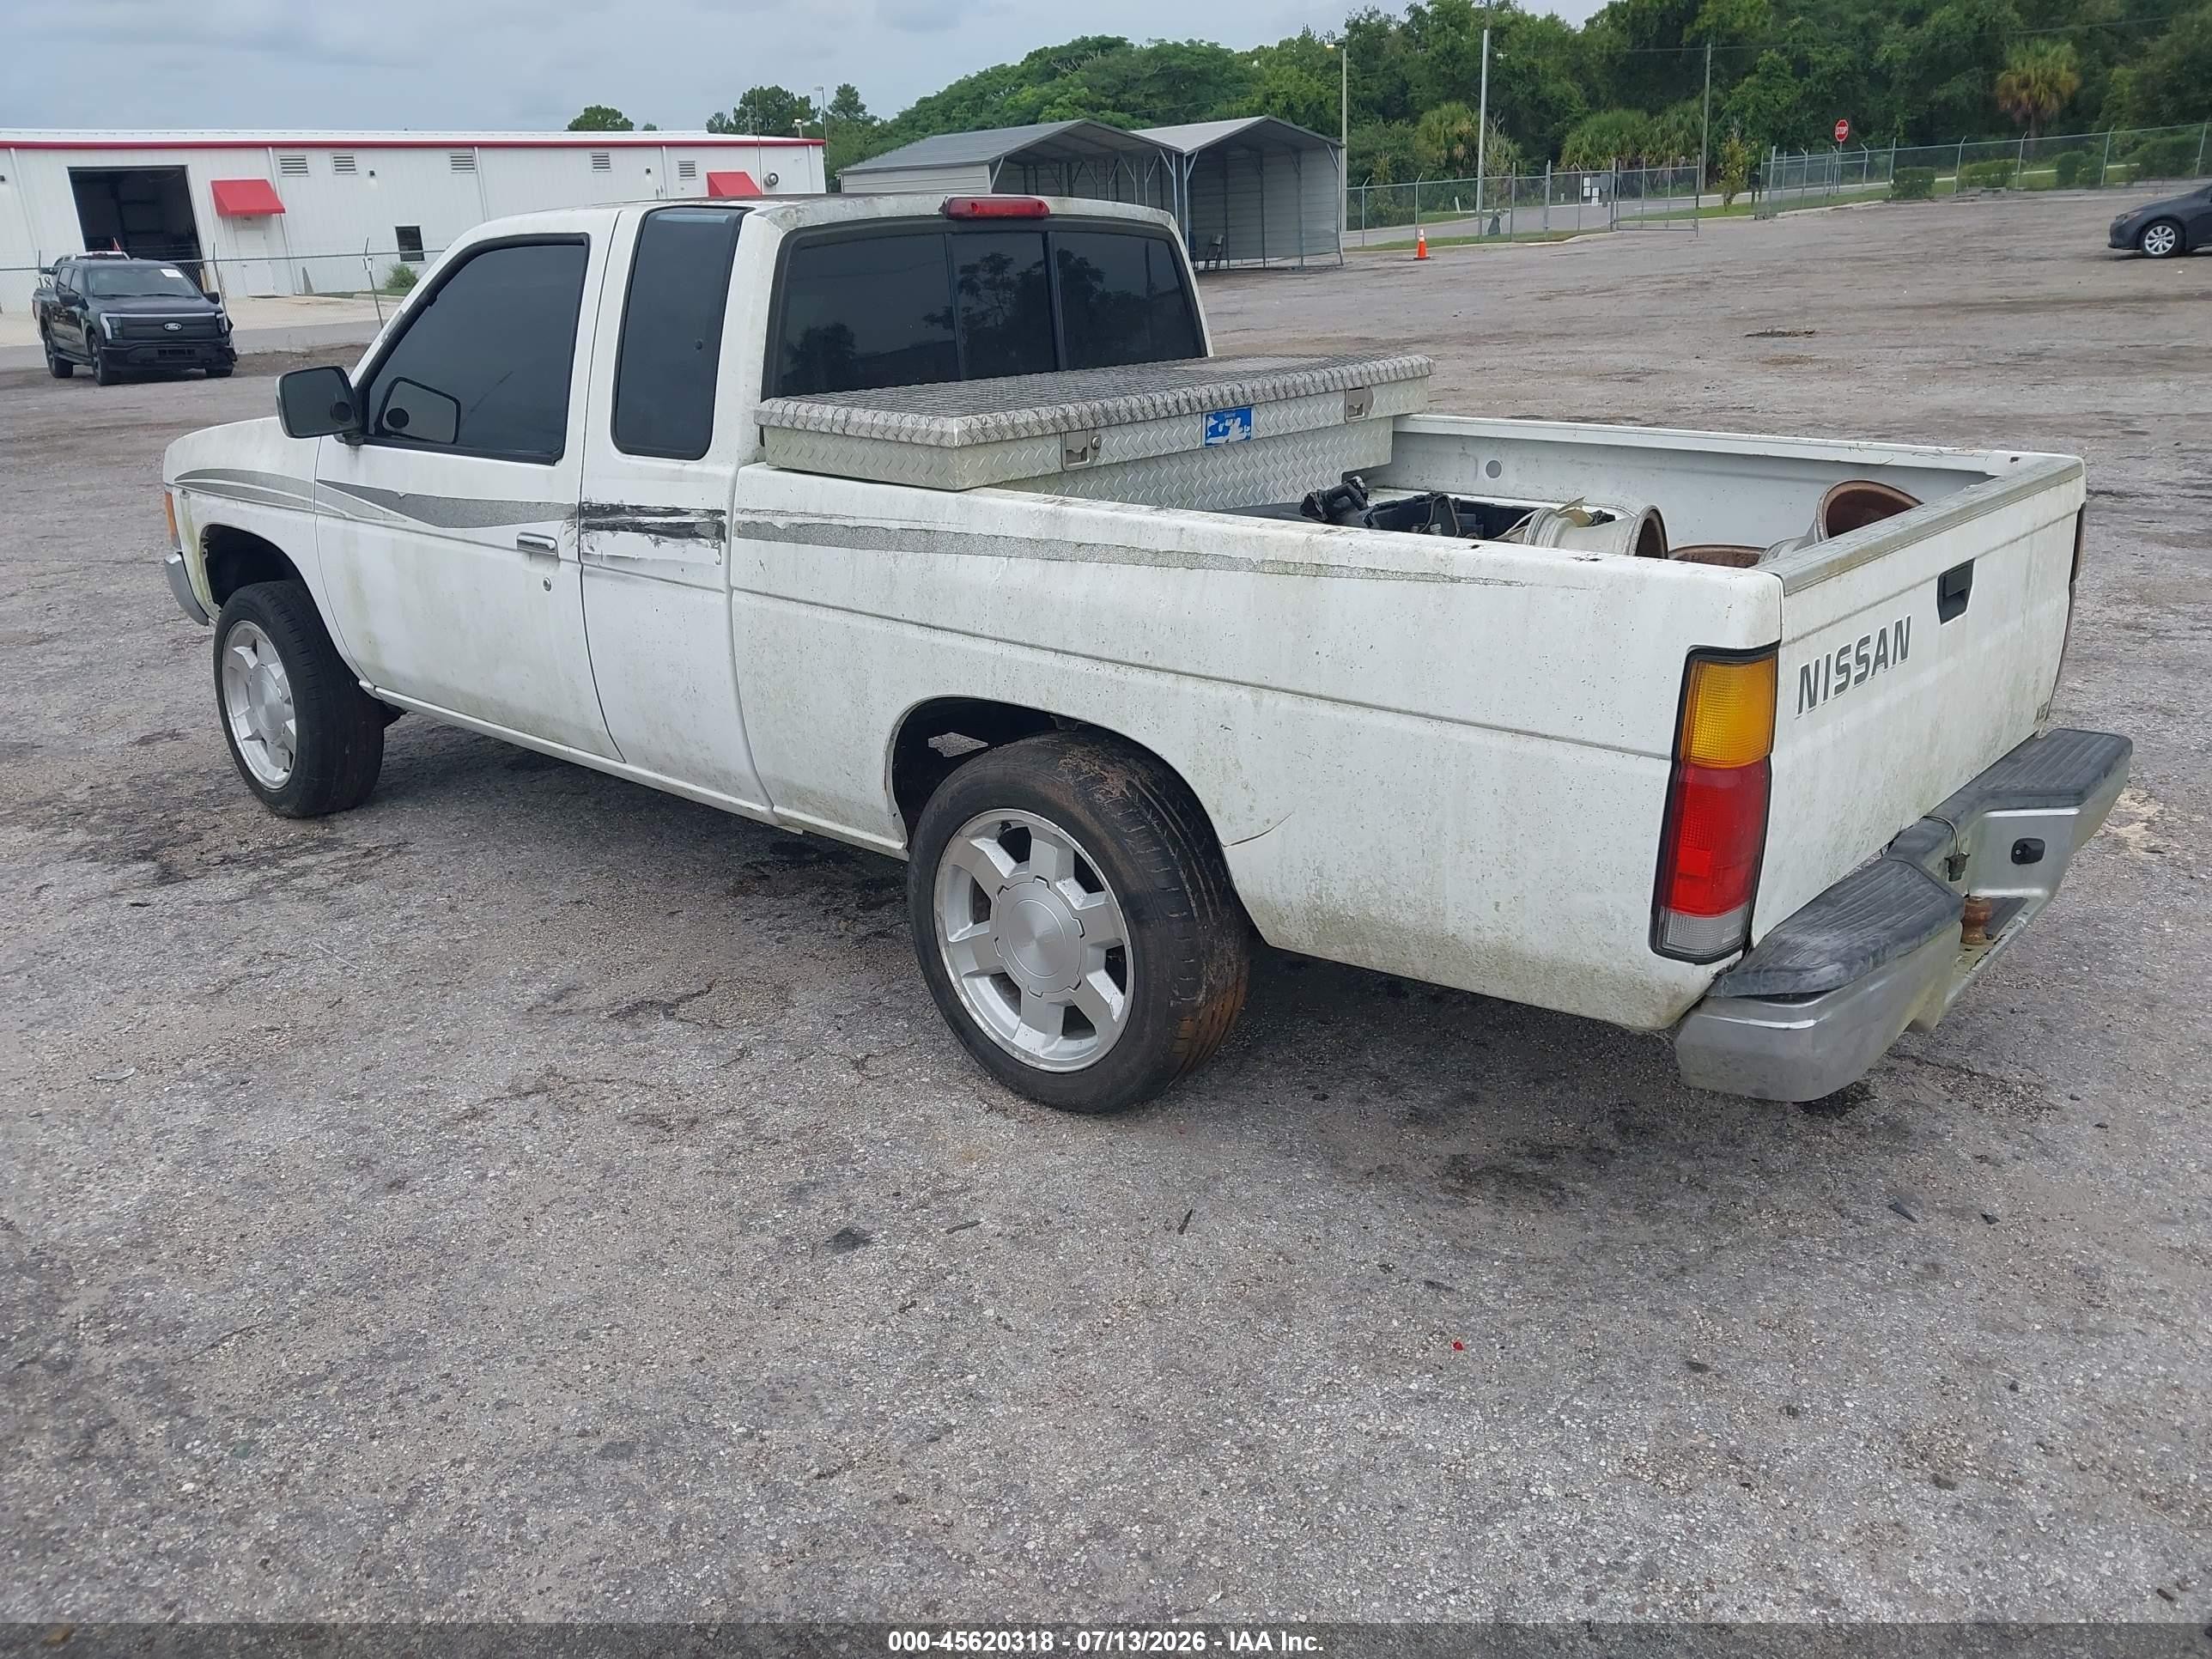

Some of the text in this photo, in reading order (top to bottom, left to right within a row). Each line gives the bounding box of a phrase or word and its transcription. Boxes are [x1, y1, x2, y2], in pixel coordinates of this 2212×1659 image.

[362, 258, 374, 270] 17
[38, 276, 53, 289] 18
[1796, 614, 1911, 716] NISSAN
